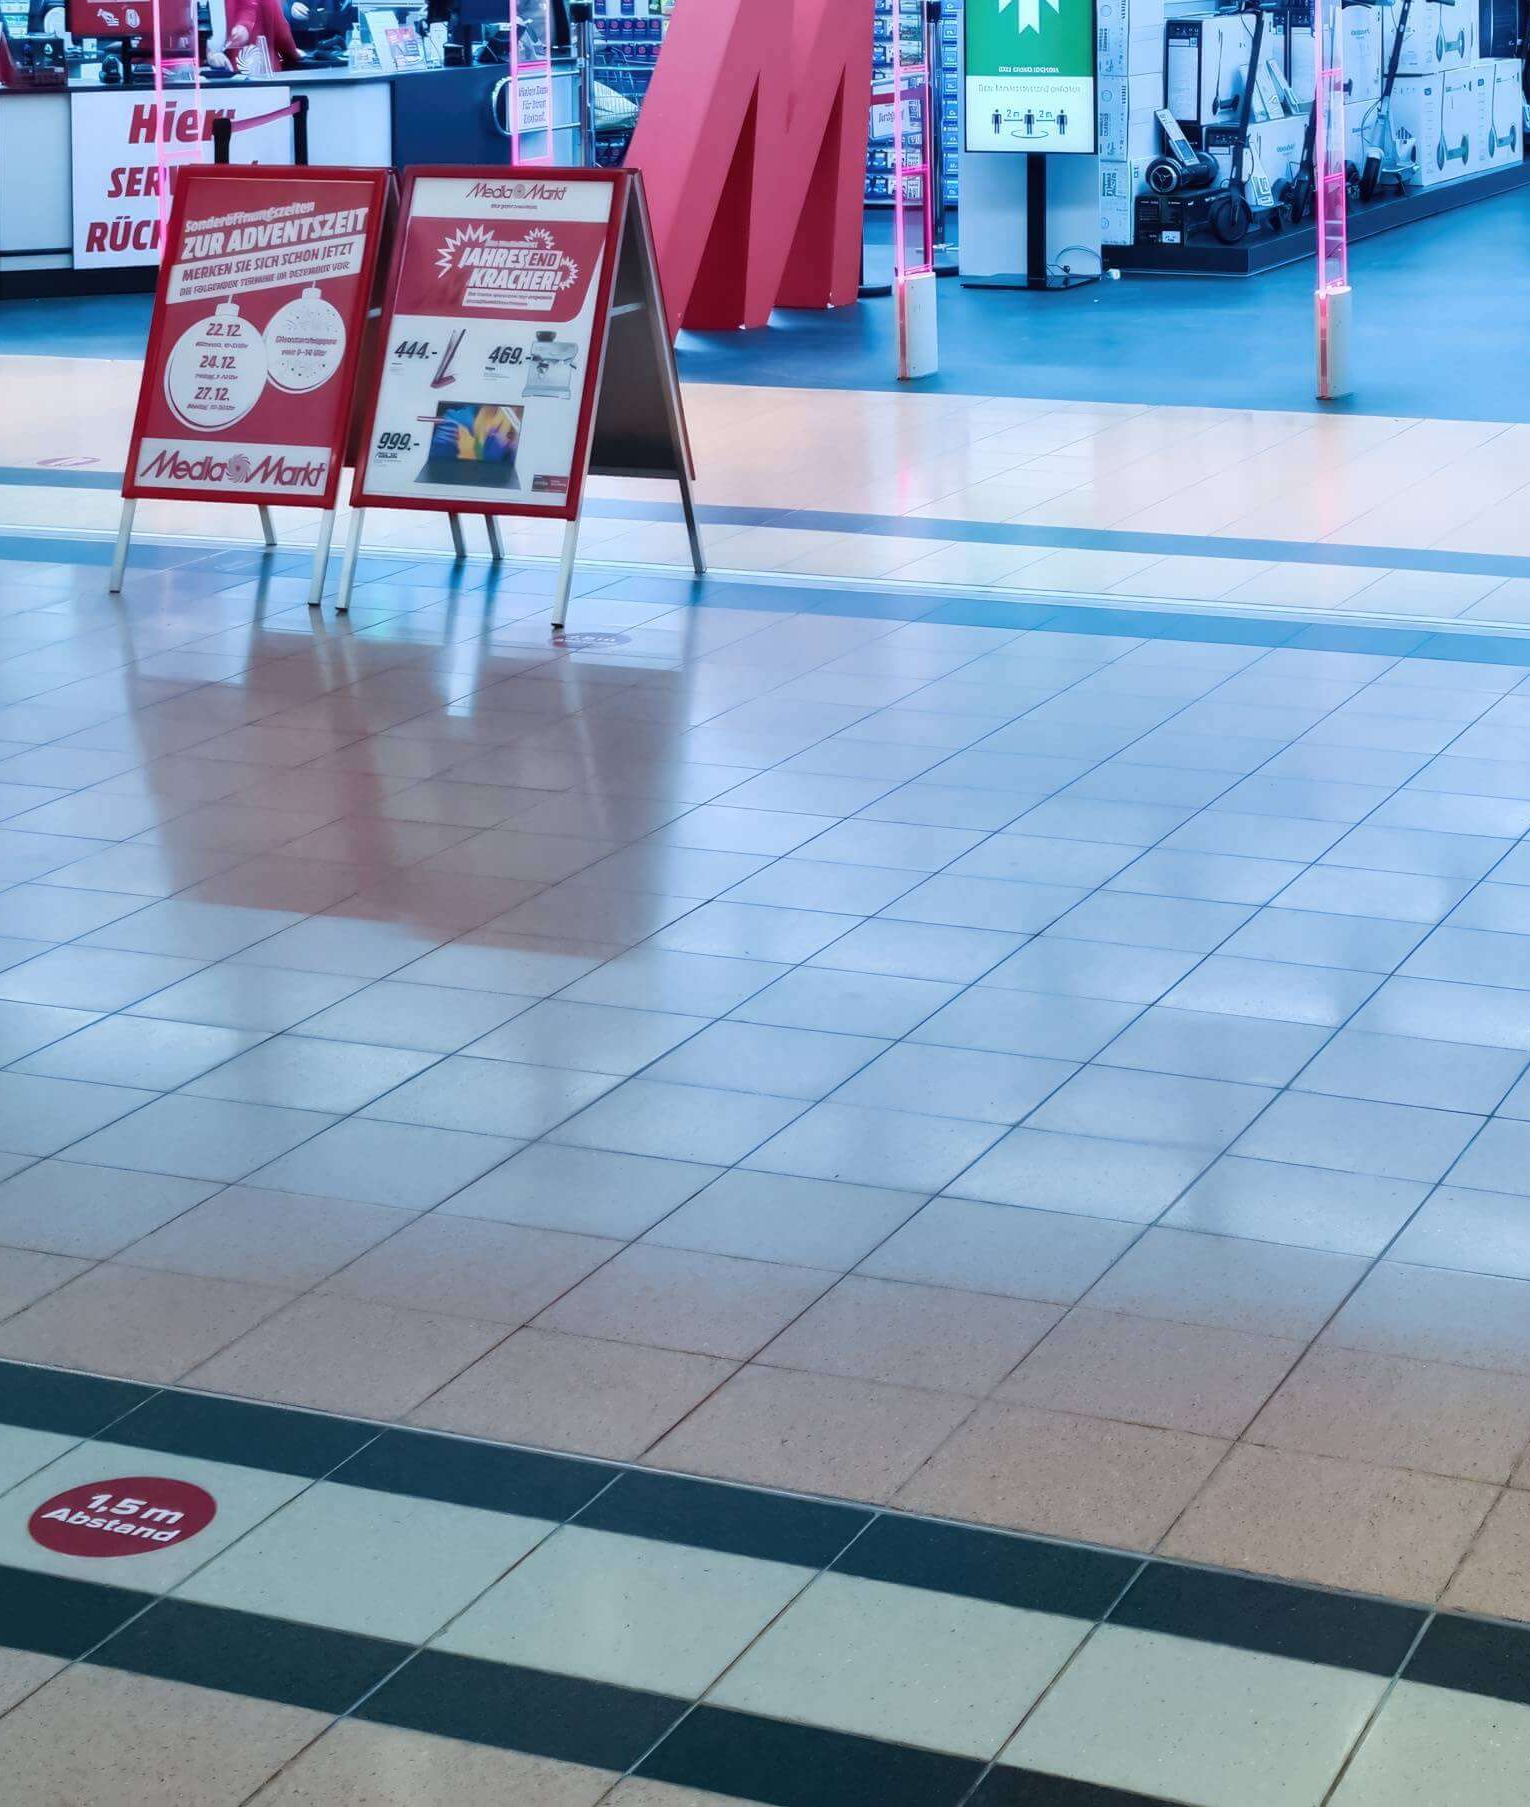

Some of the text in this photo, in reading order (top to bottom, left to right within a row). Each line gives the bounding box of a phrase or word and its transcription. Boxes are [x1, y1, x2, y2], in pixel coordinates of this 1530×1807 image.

[466, 182, 568, 201] Media Markt
[181, 206, 369, 261] ZUR ADVENTSZEIT
[182, 241, 355, 282] MERKEN SIE SICH SCHON JETZT
[468, 266, 563, 291] KRACHER!
[205, 322, 242, 337] 22.12.
[199, 355, 237, 369] 24.12.
[194, 386, 230, 401] 27.12.
[140, 449, 326, 487] Media Markt
[86, 1493, 185, 1525] 1,5 m
[41, 1507, 182, 1543] Abstand
